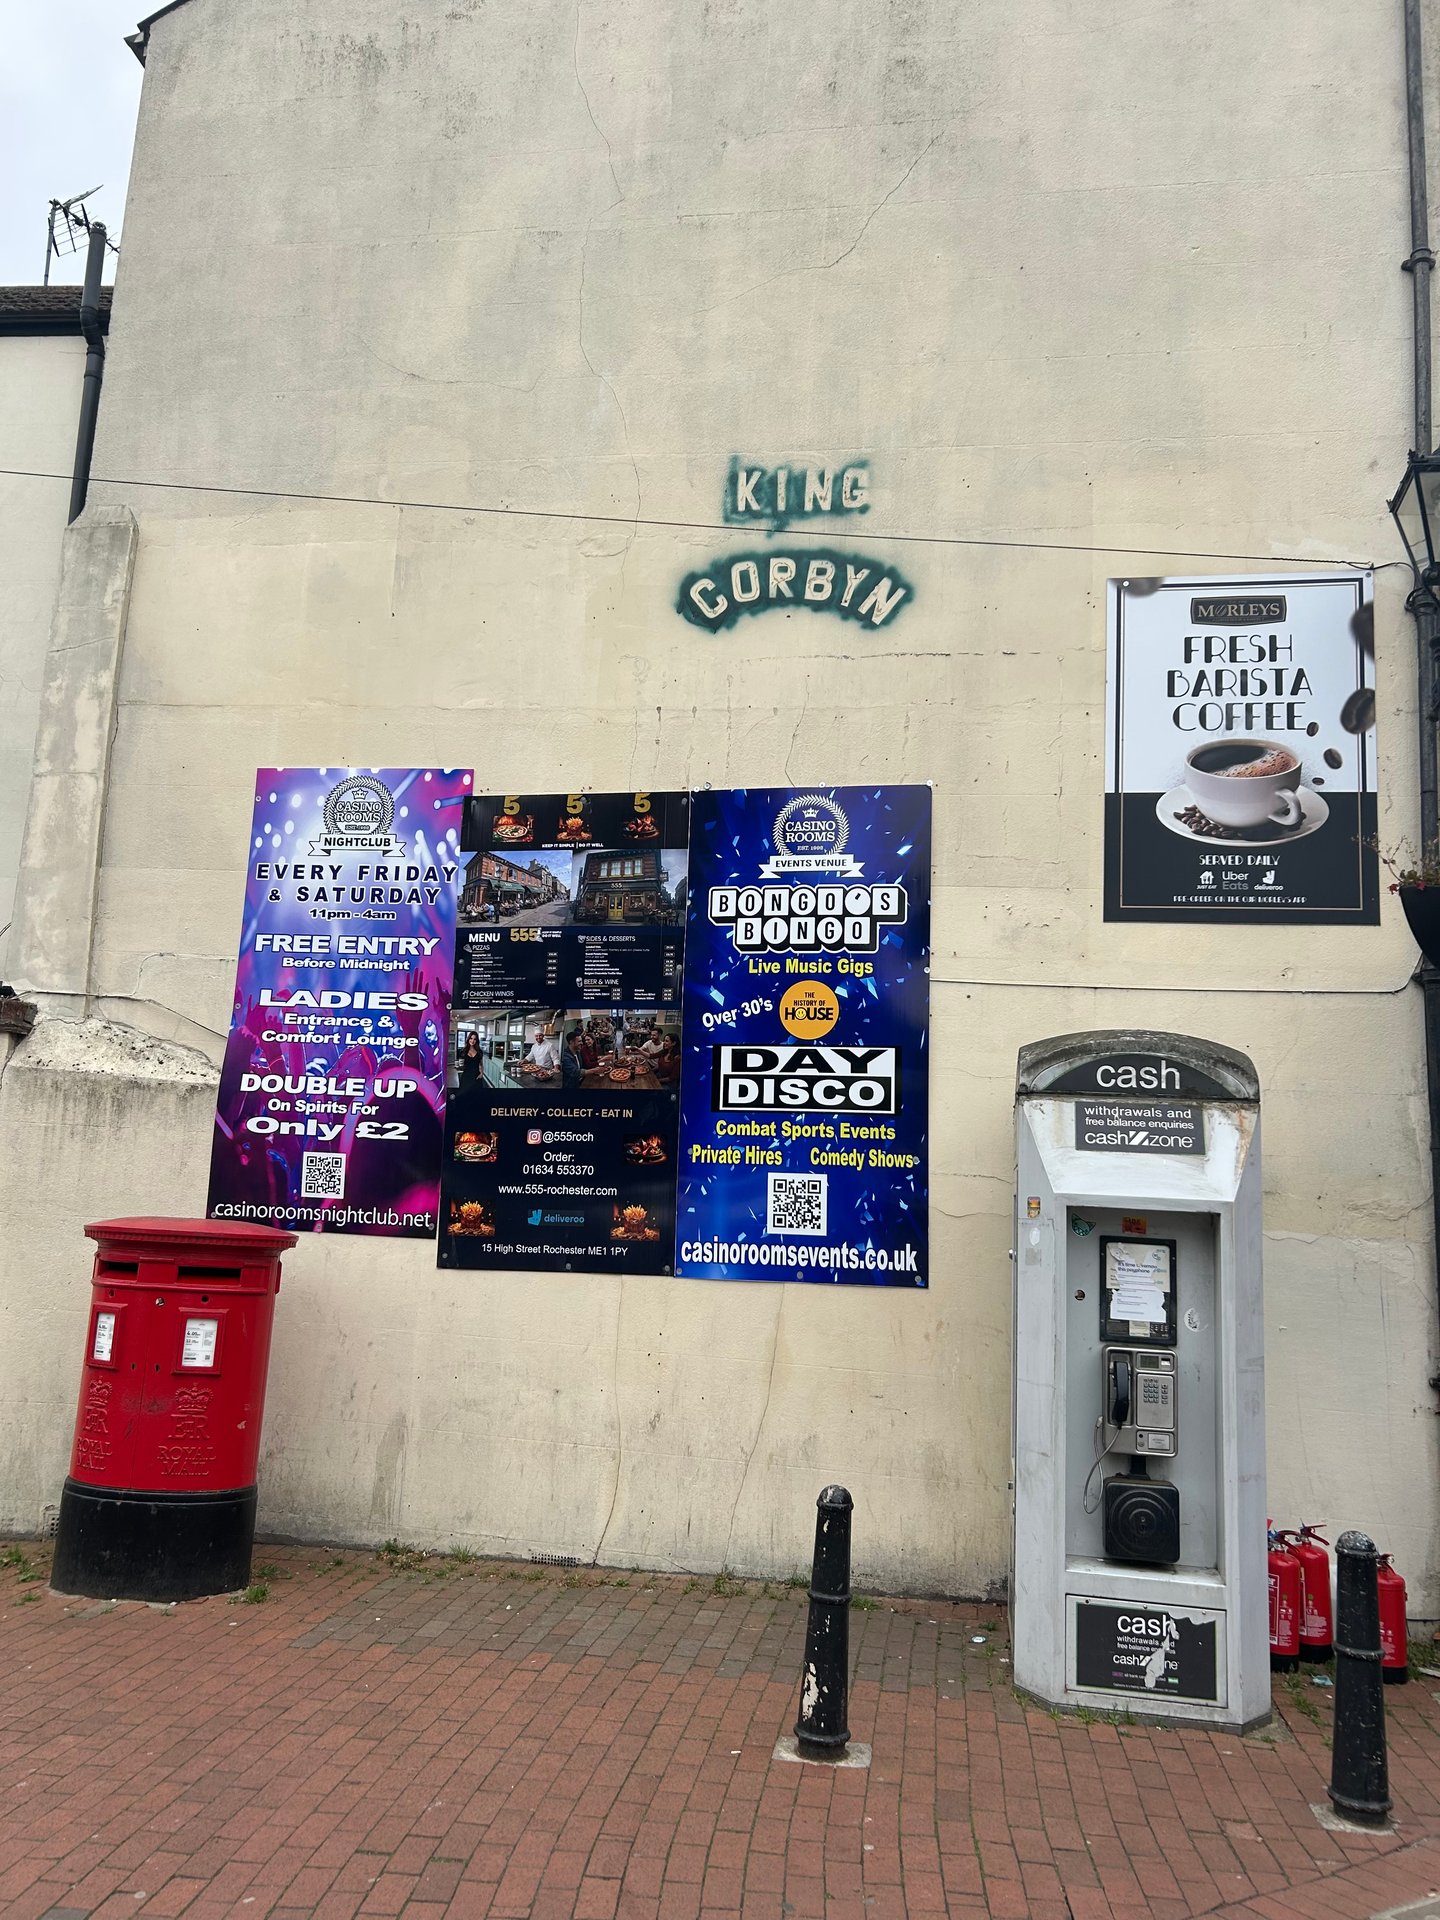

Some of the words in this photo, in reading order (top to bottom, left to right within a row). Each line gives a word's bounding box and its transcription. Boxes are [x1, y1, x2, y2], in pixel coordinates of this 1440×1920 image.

[737, 468, 870, 512] KING
[690, 557, 906, 626] CORBYN
[1184, 634, 1293, 664] FRESH
[1167, 668, 1313, 698] BARISTA
[1172, 702, 1307, 732] COFFEE
[336, 801, 382, 812] CASINO
[503, 795, 521, 815] 5
[566, 794, 584, 814] 5
[633, 792, 651, 813] 5
[336, 812, 381, 822] ROOMS
[785, 821, 836, 832] CASINO
[324, 838, 391, 847] NIGHTCLUB
[785, 832, 836, 843] ROOMS
[775, 859, 812, 868] EVENTS
[814, 858, 847, 867] VENUE
[1199, 854, 1243, 866] SERVED
[1247, 855, 1280, 866] DAILY
[256, 863, 343, 881] EVERY
[358, 865, 459, 883] FRIDAY
[1222, 871, 1249, 880] Uber
[1222, 881, 1249, 890] Eats
[268, 888, 281, 902] &
[296, 886, 441, 905] SATURDAY
[719, 891, 891, 912] BONGO'S
[309, 908, 351, 921] 11pm
[362, 909, 396, 921] 4am
[468, 932, 500, 943] MENU
[510, 928, 538, 942] 555
[744, 921, 862, 940] BINGO
[255, 934, 331, 953] FREE
[338, 936, 440, 956] ENTRY
[282, 957, 335, 969] Before
[339, 958, 410, 972] Midnight
[748, 958, 781, 974] Live
[785, 958, 832, 974] Music
[837, 958, 874, 977] Gigs
[259, 989, 429, 1011] LADIES
[804, 991, 815, 999] THE
[283, 1013, 372, 1028] Entrance
[377, 1015, 394, 1028] &
[702, 1007, 738, 1028] Over
[740, 997, 773, 1017] 30's
[784, 1007, 834, 1021] HOUSE
[261, 1030, 340, 1045] Comfort
[345, 1032, 419, 1049] Lounge
[731, 1048, 888, 1074] DAY
[1096, 1059, 1181, 1090] cash
[240, 1074, 366, 1097] DOUBLE
[373, 1079, 418, 1099] UP
[728, 1078, 885, 1107] DISCO
[267, 1098, 291, 1111] On
[294, 1099, 348, 1115] Spirits
[351, 1102, 379, 1116] For
[490, 1107, 539, 1117] DELIVERY
[547, 1108, 593, 1118] COLLECT
[601, 1109, 620, 1118] EAT
[622, 1109, 633, 1118] IN
[1084, 1105, 1162, 1118] withdrawals
[1167, 1107, 1192, 1119] and
[246, 1117, 346, 1141] Only
[355, 1122, 409, 1140] £2
[716, 1119, 777, 1137] Combat
[781, 1121, 835, 1140] Sports
[839, 1122, 896, 1140] Events
[1085, 1117, 1105, 1126] free
[1107, 1117, 1146, 1128] balance
[1148, 1120, 1194, 1130] enquiries
[542, 1131, 594, 1143] @555roch
[543, 1152, 575, 1162] Order:
[691, 1144, 741, 1165] Private
[745, 1145, 783, 1166] Hires
[810, 1147, 865, 1171] Comedy
[868, 1149, 914, 1169] Shows
[522, 1164, 554, 1175] 01634
[556, 1165, 594, 1176] 553370
[498, 1184, 618, 1196] www.555-rochester.com
[214, 1200, 431, 1228] casinoroomsnightclub.net
[543, 1213, 585, 1224] deliveroo
[481, 1244, 492, 1253] 15
[494, 1243, 514, 1254] High
[515, 1244, 541, 1254] Street
[543, 1245, 587, 1255] Rochester
[588, 1246, 607, 1256] ME1
[609, 1247, 628, 1257] 1PY
[681, 1236, 918, 1272] casinoroomsevents.co.uk
[77, 1438, 112, 1456] ROYAL
[157, 1445, 216, 1461] ROYAL
[161, 1461, 209, 1476] MAIL
[1117, 1614, 1176, 1637] cash
[1117, 1635, 1159, 1645] withdrawals
[1112, 1654, 1140, 1666] cash
